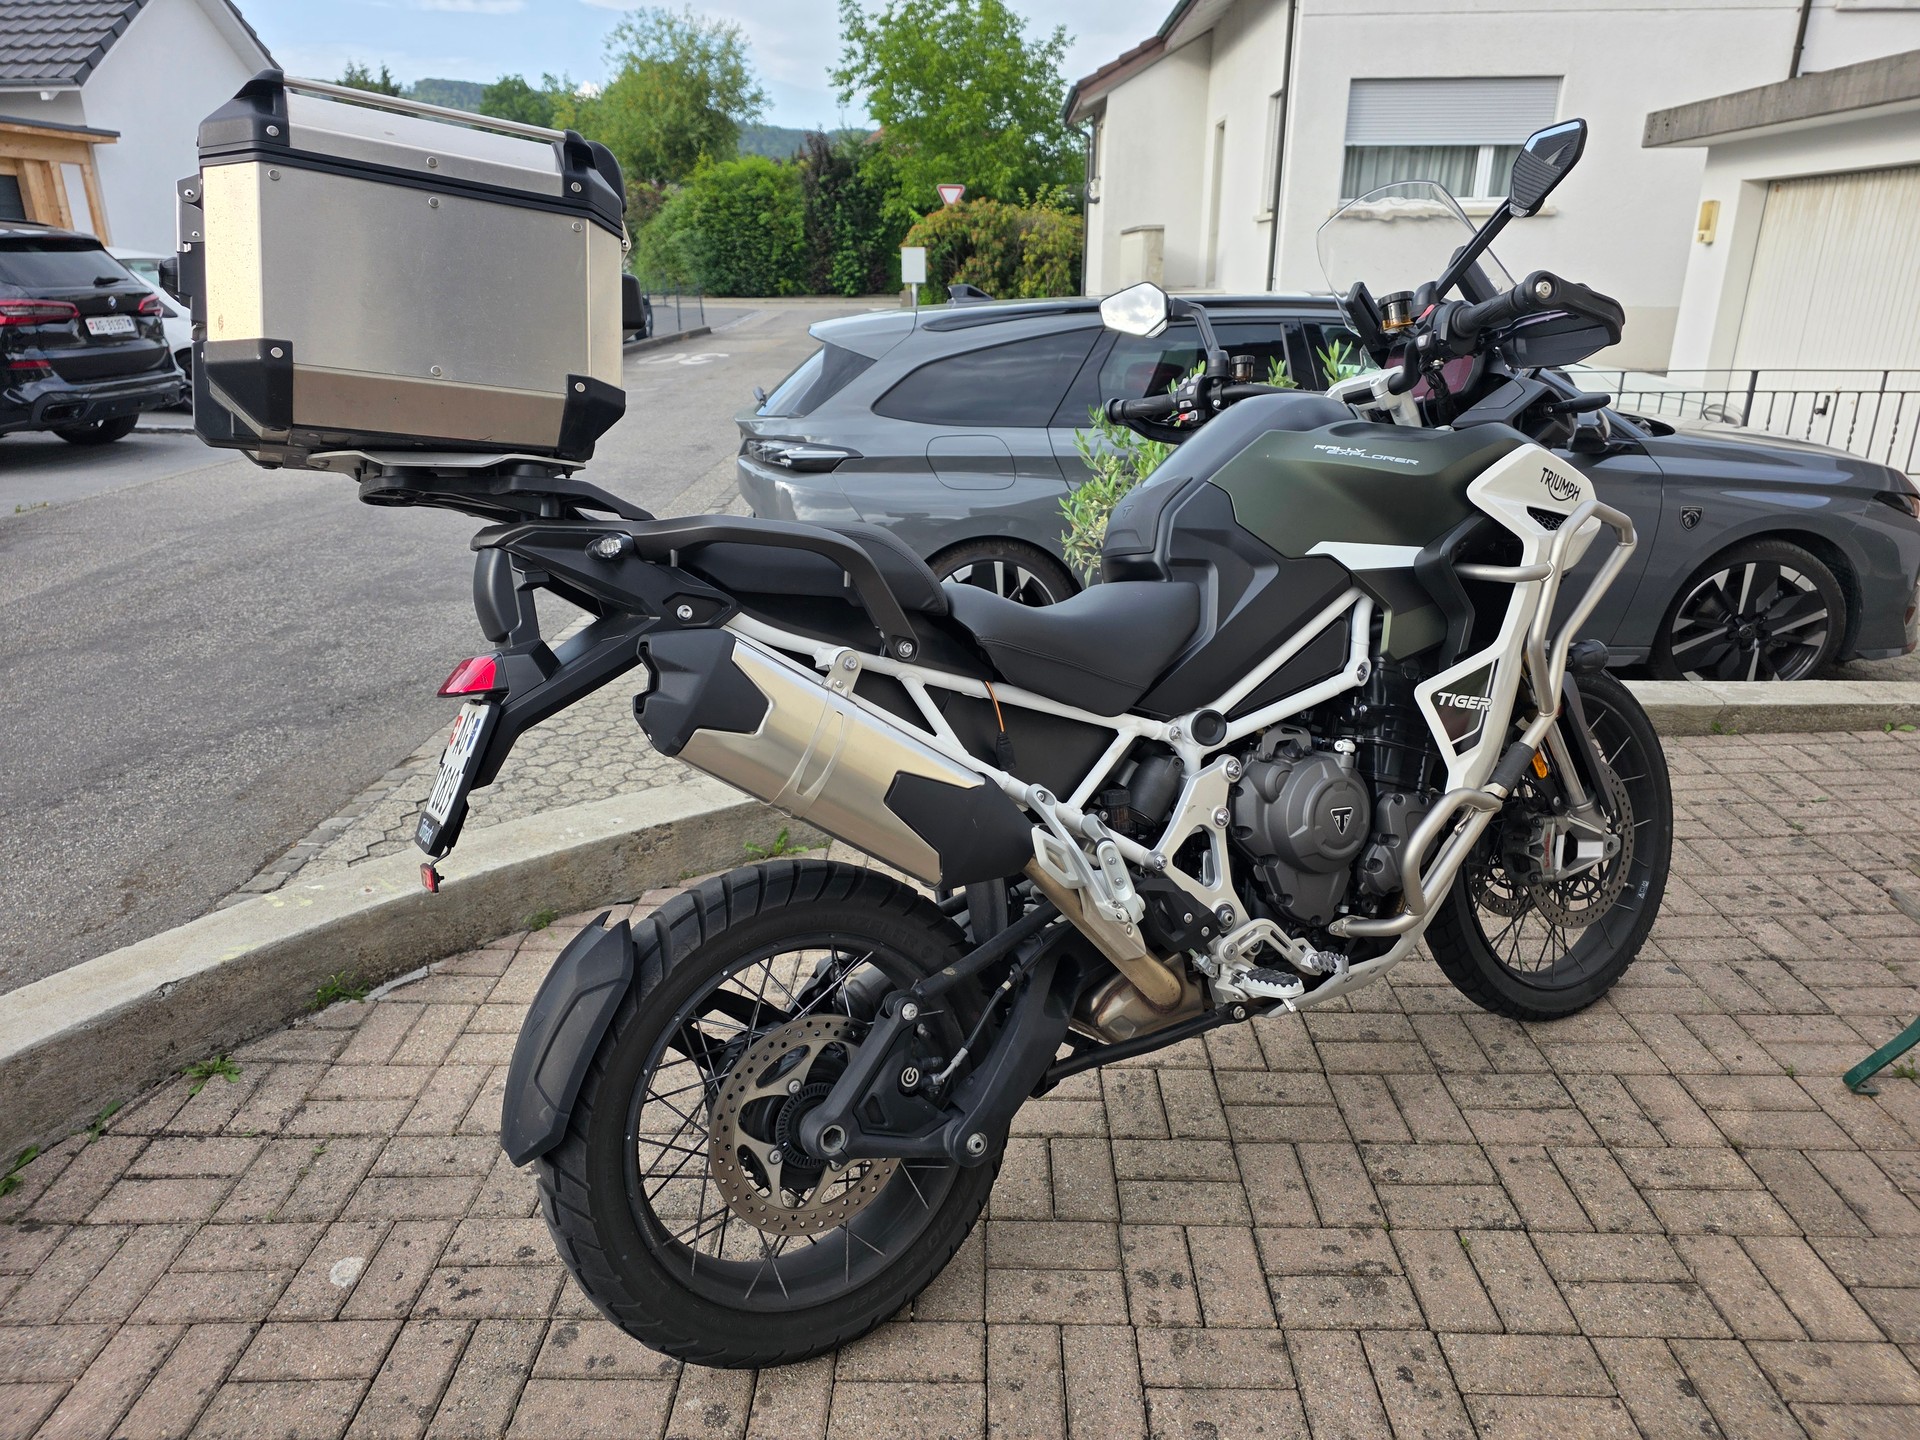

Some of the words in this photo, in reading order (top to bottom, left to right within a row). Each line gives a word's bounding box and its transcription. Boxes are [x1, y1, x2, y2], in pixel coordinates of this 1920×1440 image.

[1313, 443, 1367, 457] RALLY
[1326, 449, 1419, 466] EXPLORER
[1540, 466, 1581, 502] TRIUMPH
[1437, 691, 1493, 712] TIGER
